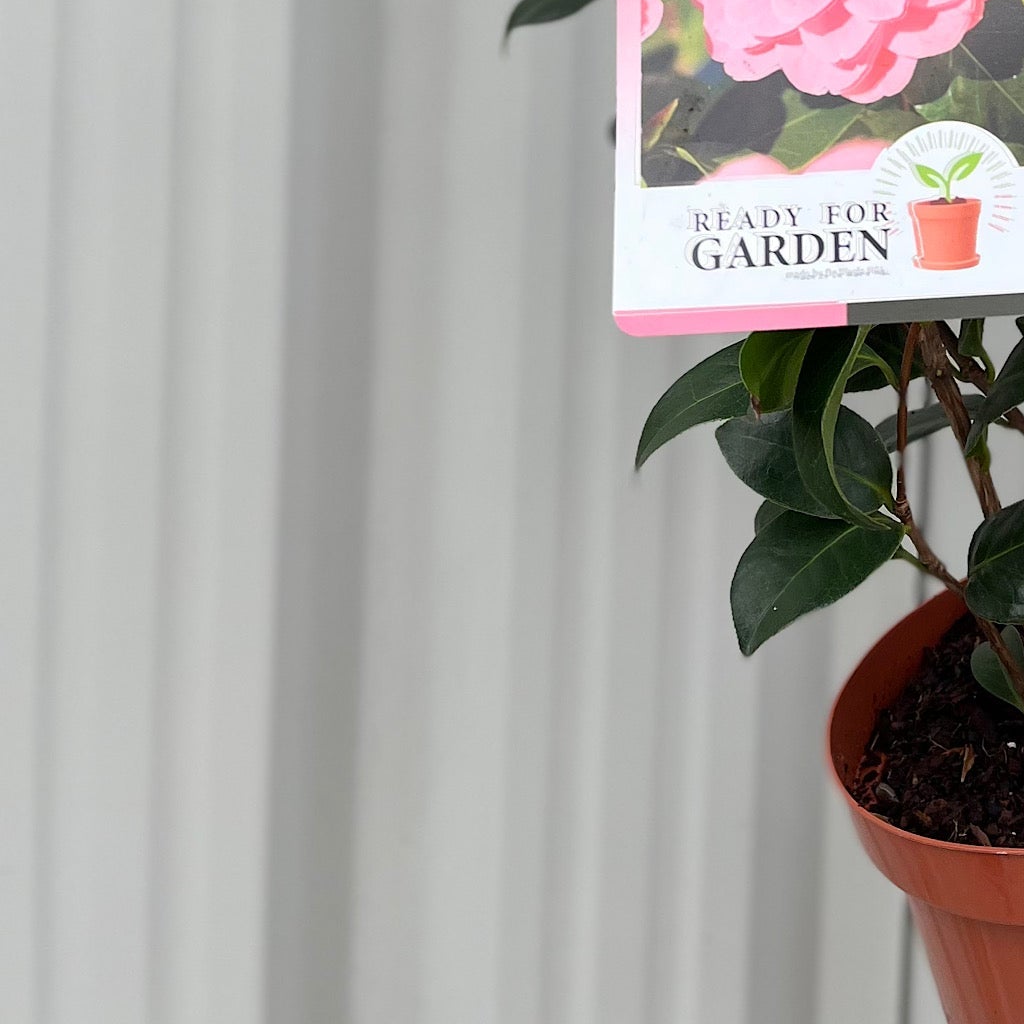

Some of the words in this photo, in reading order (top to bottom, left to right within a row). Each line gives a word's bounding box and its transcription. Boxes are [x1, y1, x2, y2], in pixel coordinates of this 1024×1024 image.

[691, 206, 803, 232] READY
[825, 201, 890, 226] FOR
[690, 228, 891, 271] GARDEN
